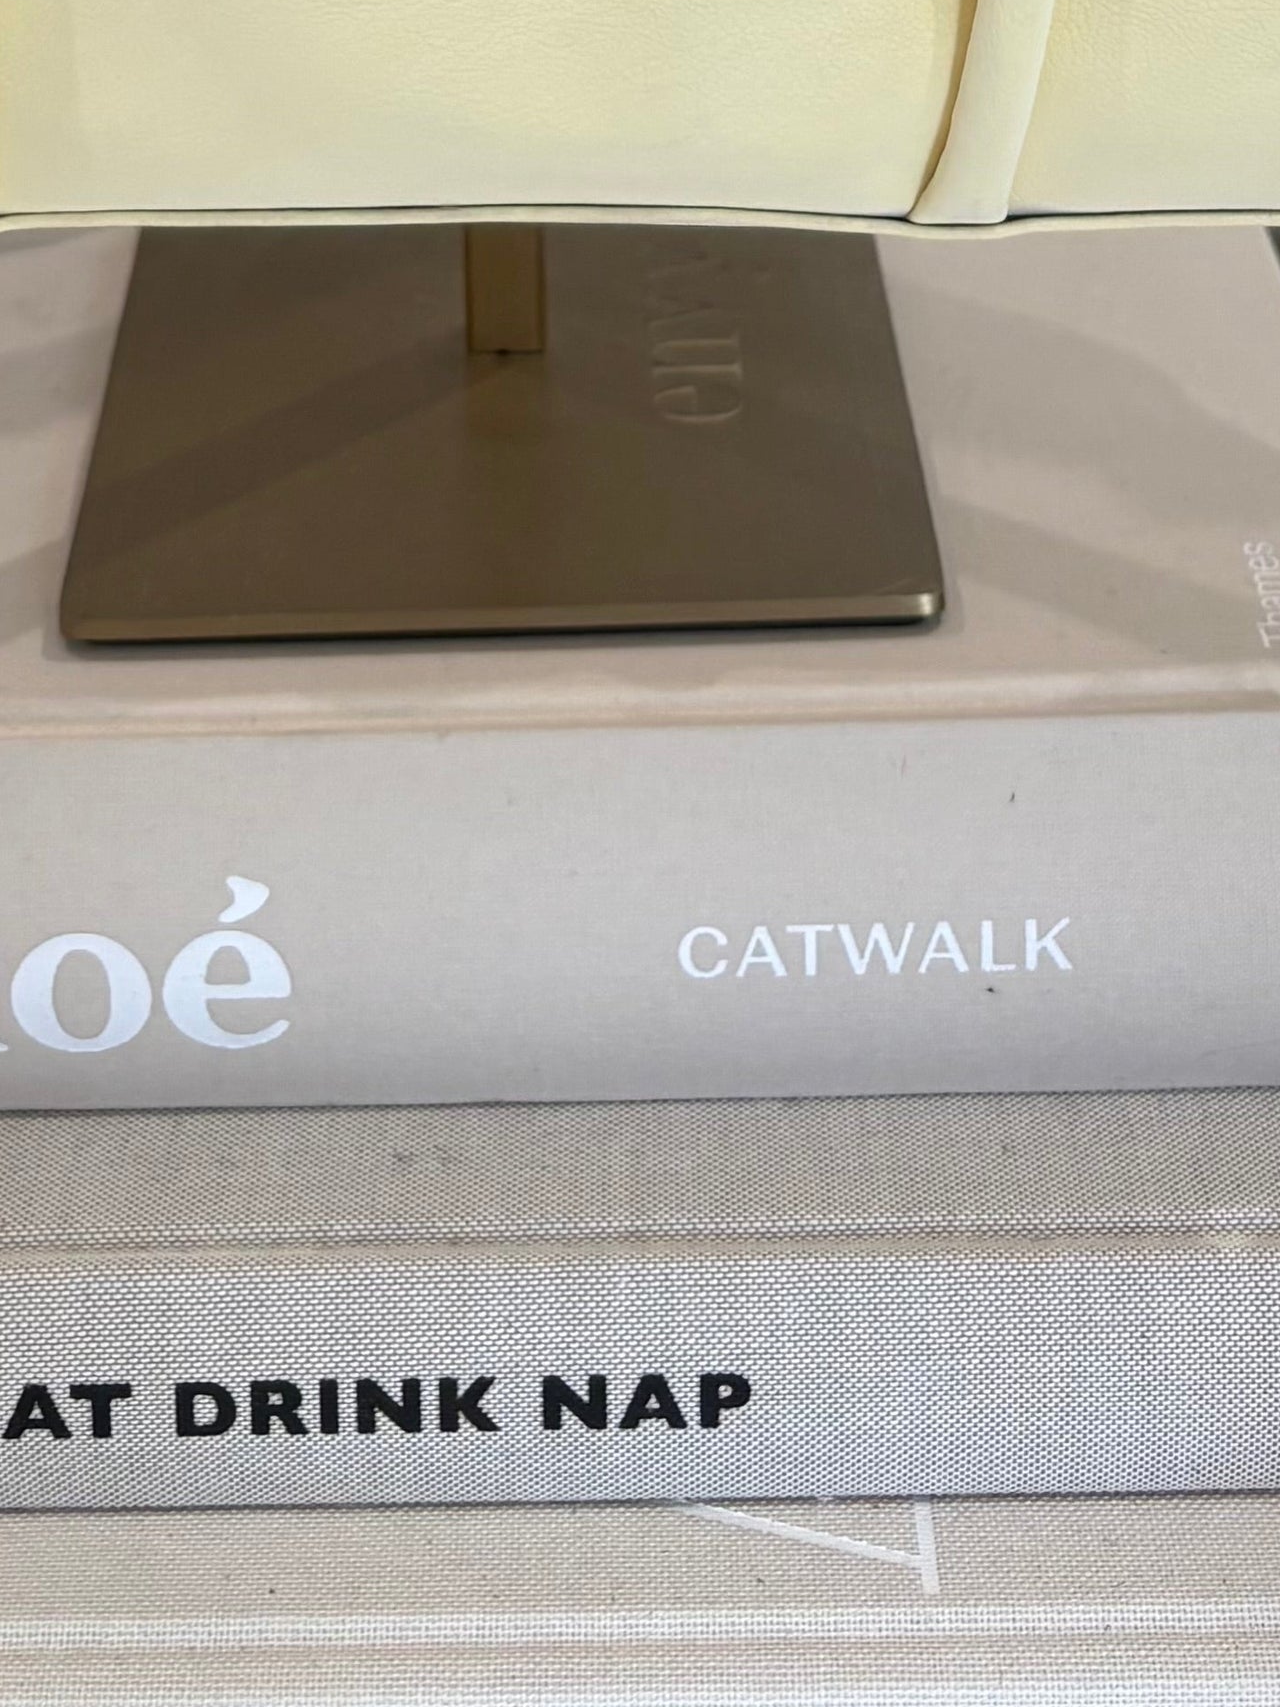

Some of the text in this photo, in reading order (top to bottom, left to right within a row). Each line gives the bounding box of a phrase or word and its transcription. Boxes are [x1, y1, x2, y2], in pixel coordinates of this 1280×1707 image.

[678, 917, 1073, 979] CATWALK
[174, 1375, 501, 1439] DRINK
[542, 1372, 752, 1432] NAP
